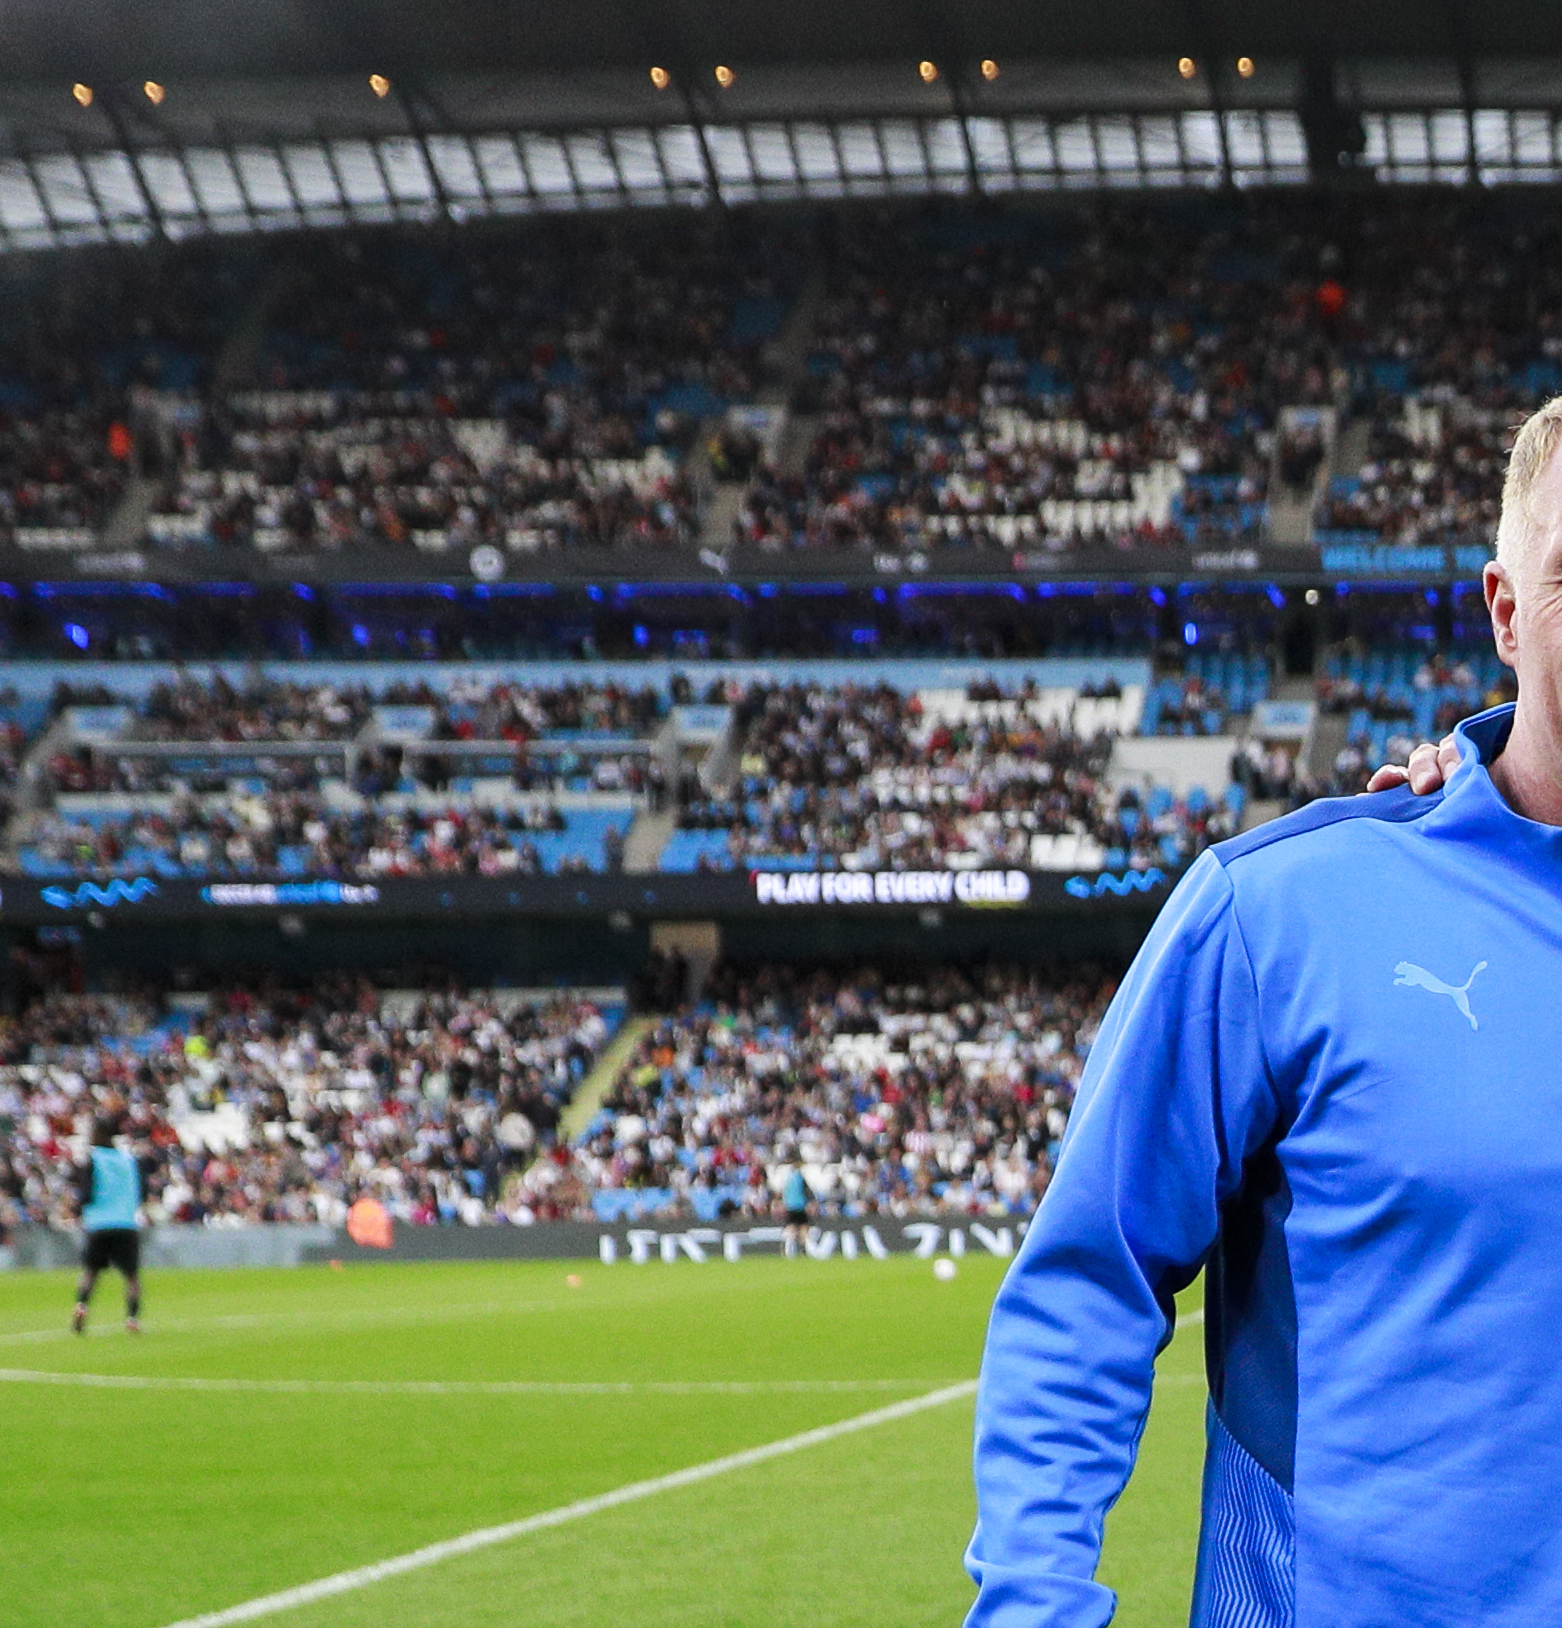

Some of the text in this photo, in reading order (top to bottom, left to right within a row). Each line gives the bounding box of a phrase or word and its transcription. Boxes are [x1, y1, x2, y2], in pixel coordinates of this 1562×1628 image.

[756, 870, 1030, 904] PLAY FOR EVERY CHILD
